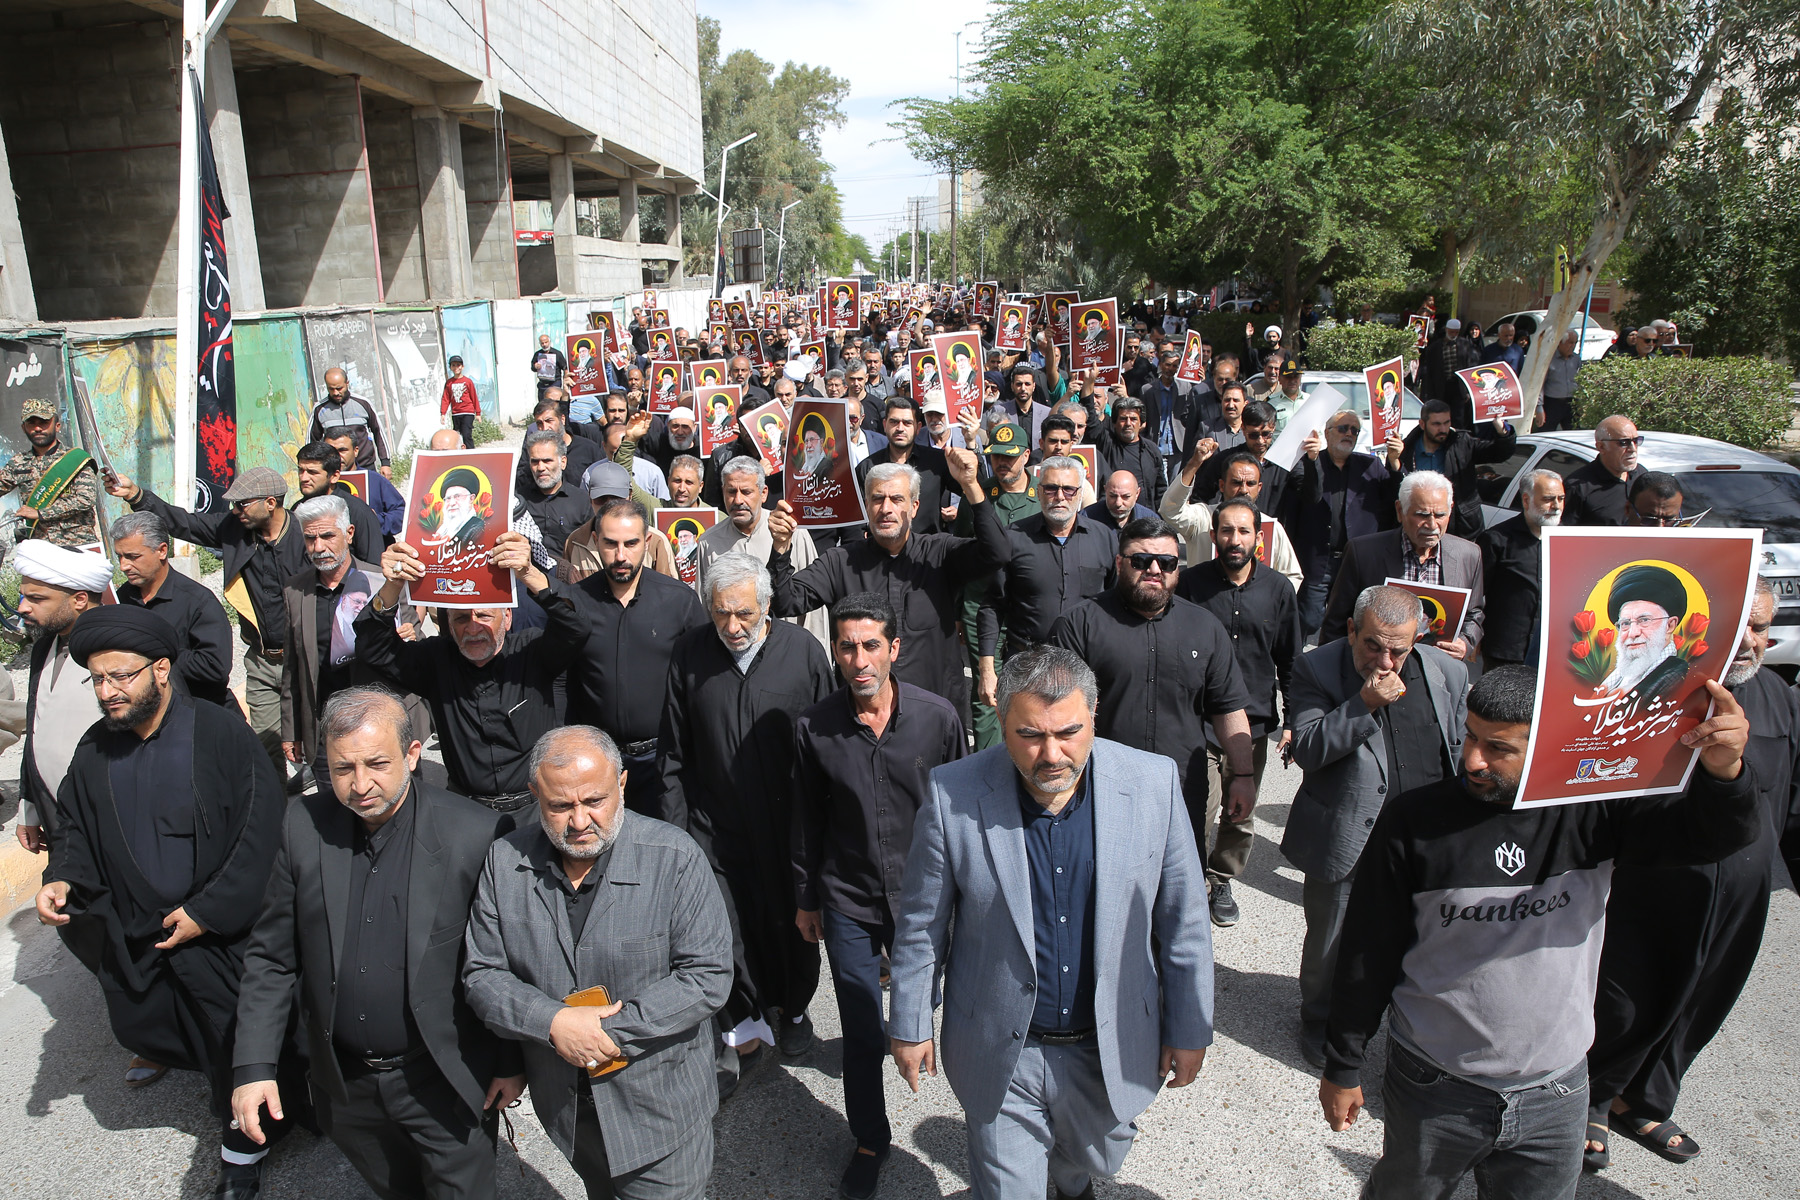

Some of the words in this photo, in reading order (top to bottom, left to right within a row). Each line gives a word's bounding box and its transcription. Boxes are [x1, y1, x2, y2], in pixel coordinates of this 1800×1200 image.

[314, 324, 335, 338] ROOF
[412, 318, 427, 338] فود
[7, 353, 42, 387] شهر
[1573, 687, 1641, 735] انقلاب
[1606, 695, 1662, 746] شهید
[1633, 700, 1684, 742] رهبر
[1440, 890, 1571, 928] yankees
